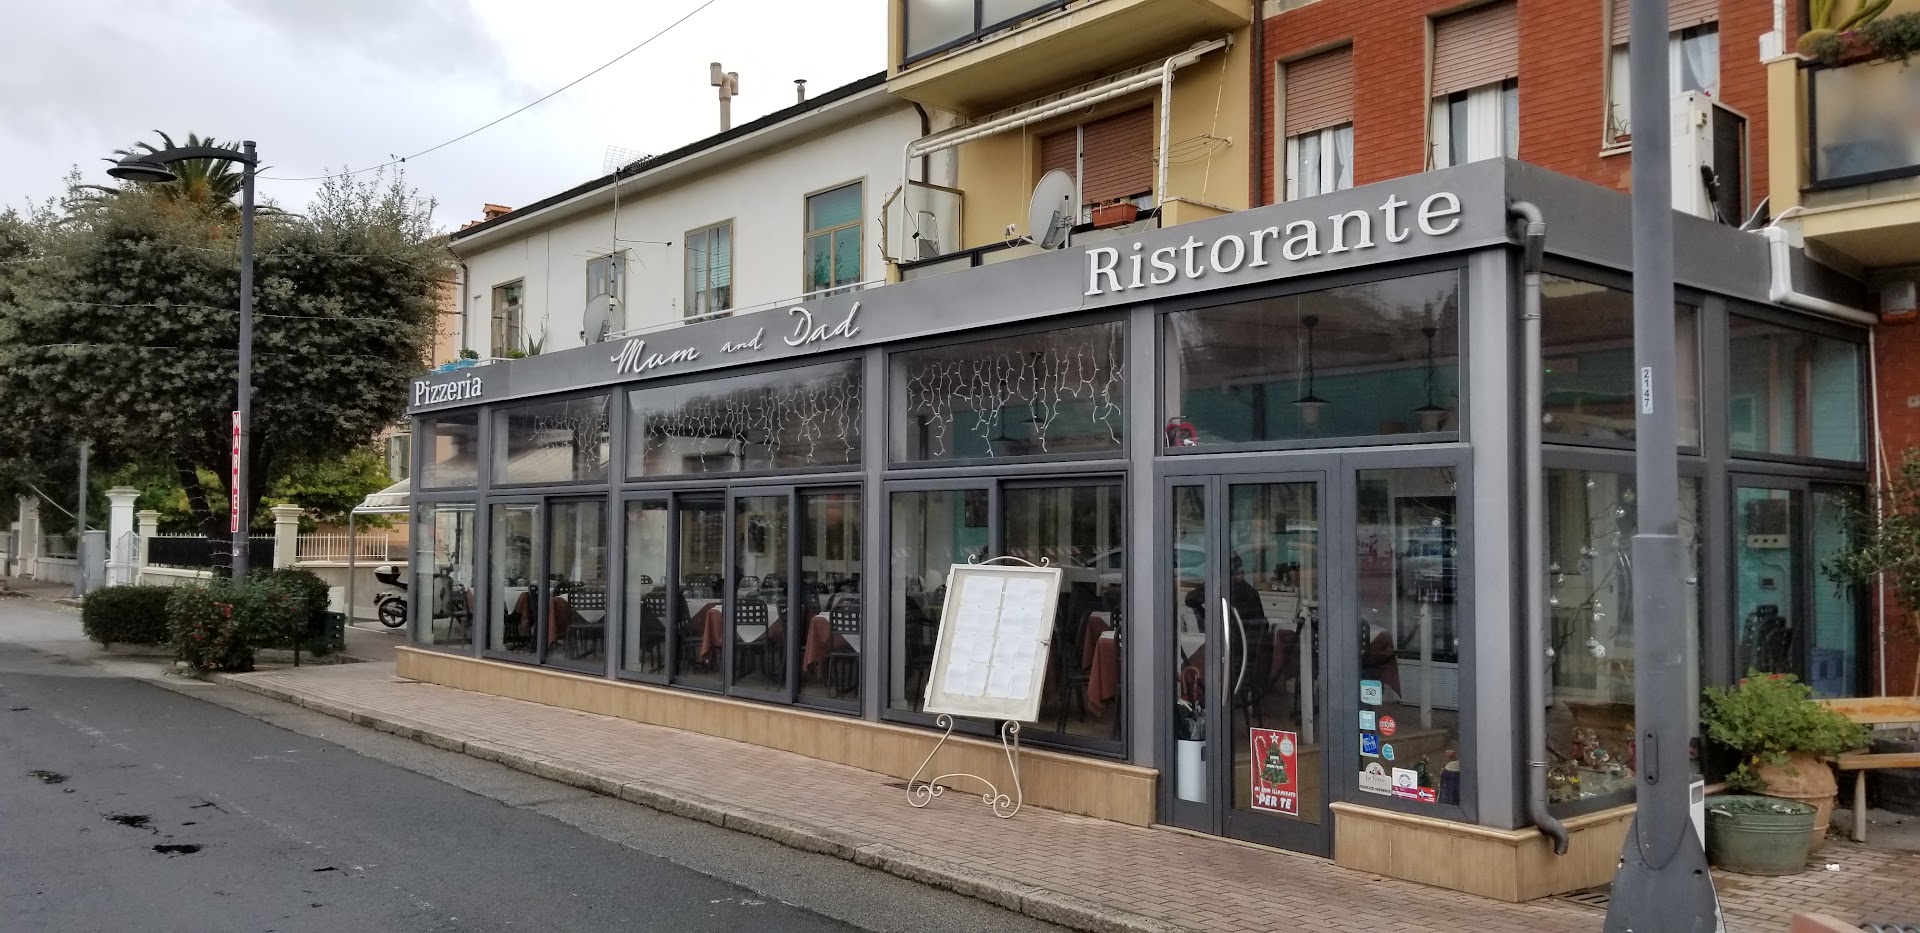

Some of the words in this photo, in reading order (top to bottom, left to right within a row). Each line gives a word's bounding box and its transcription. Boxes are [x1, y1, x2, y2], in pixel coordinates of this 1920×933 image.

[1084, 191, 1462, 297] Ristorante
[610, 338, 702, 375] Mum
[719, 327, 765, 355] and
[783, 301, 862, 347] Dad
[413, 373, 483, 407] Pizzeria
[232, 411, 240, 532] MARKET
[1257, 793, 1278, 807] PER
[1279, 797, 1293, 810] TE
